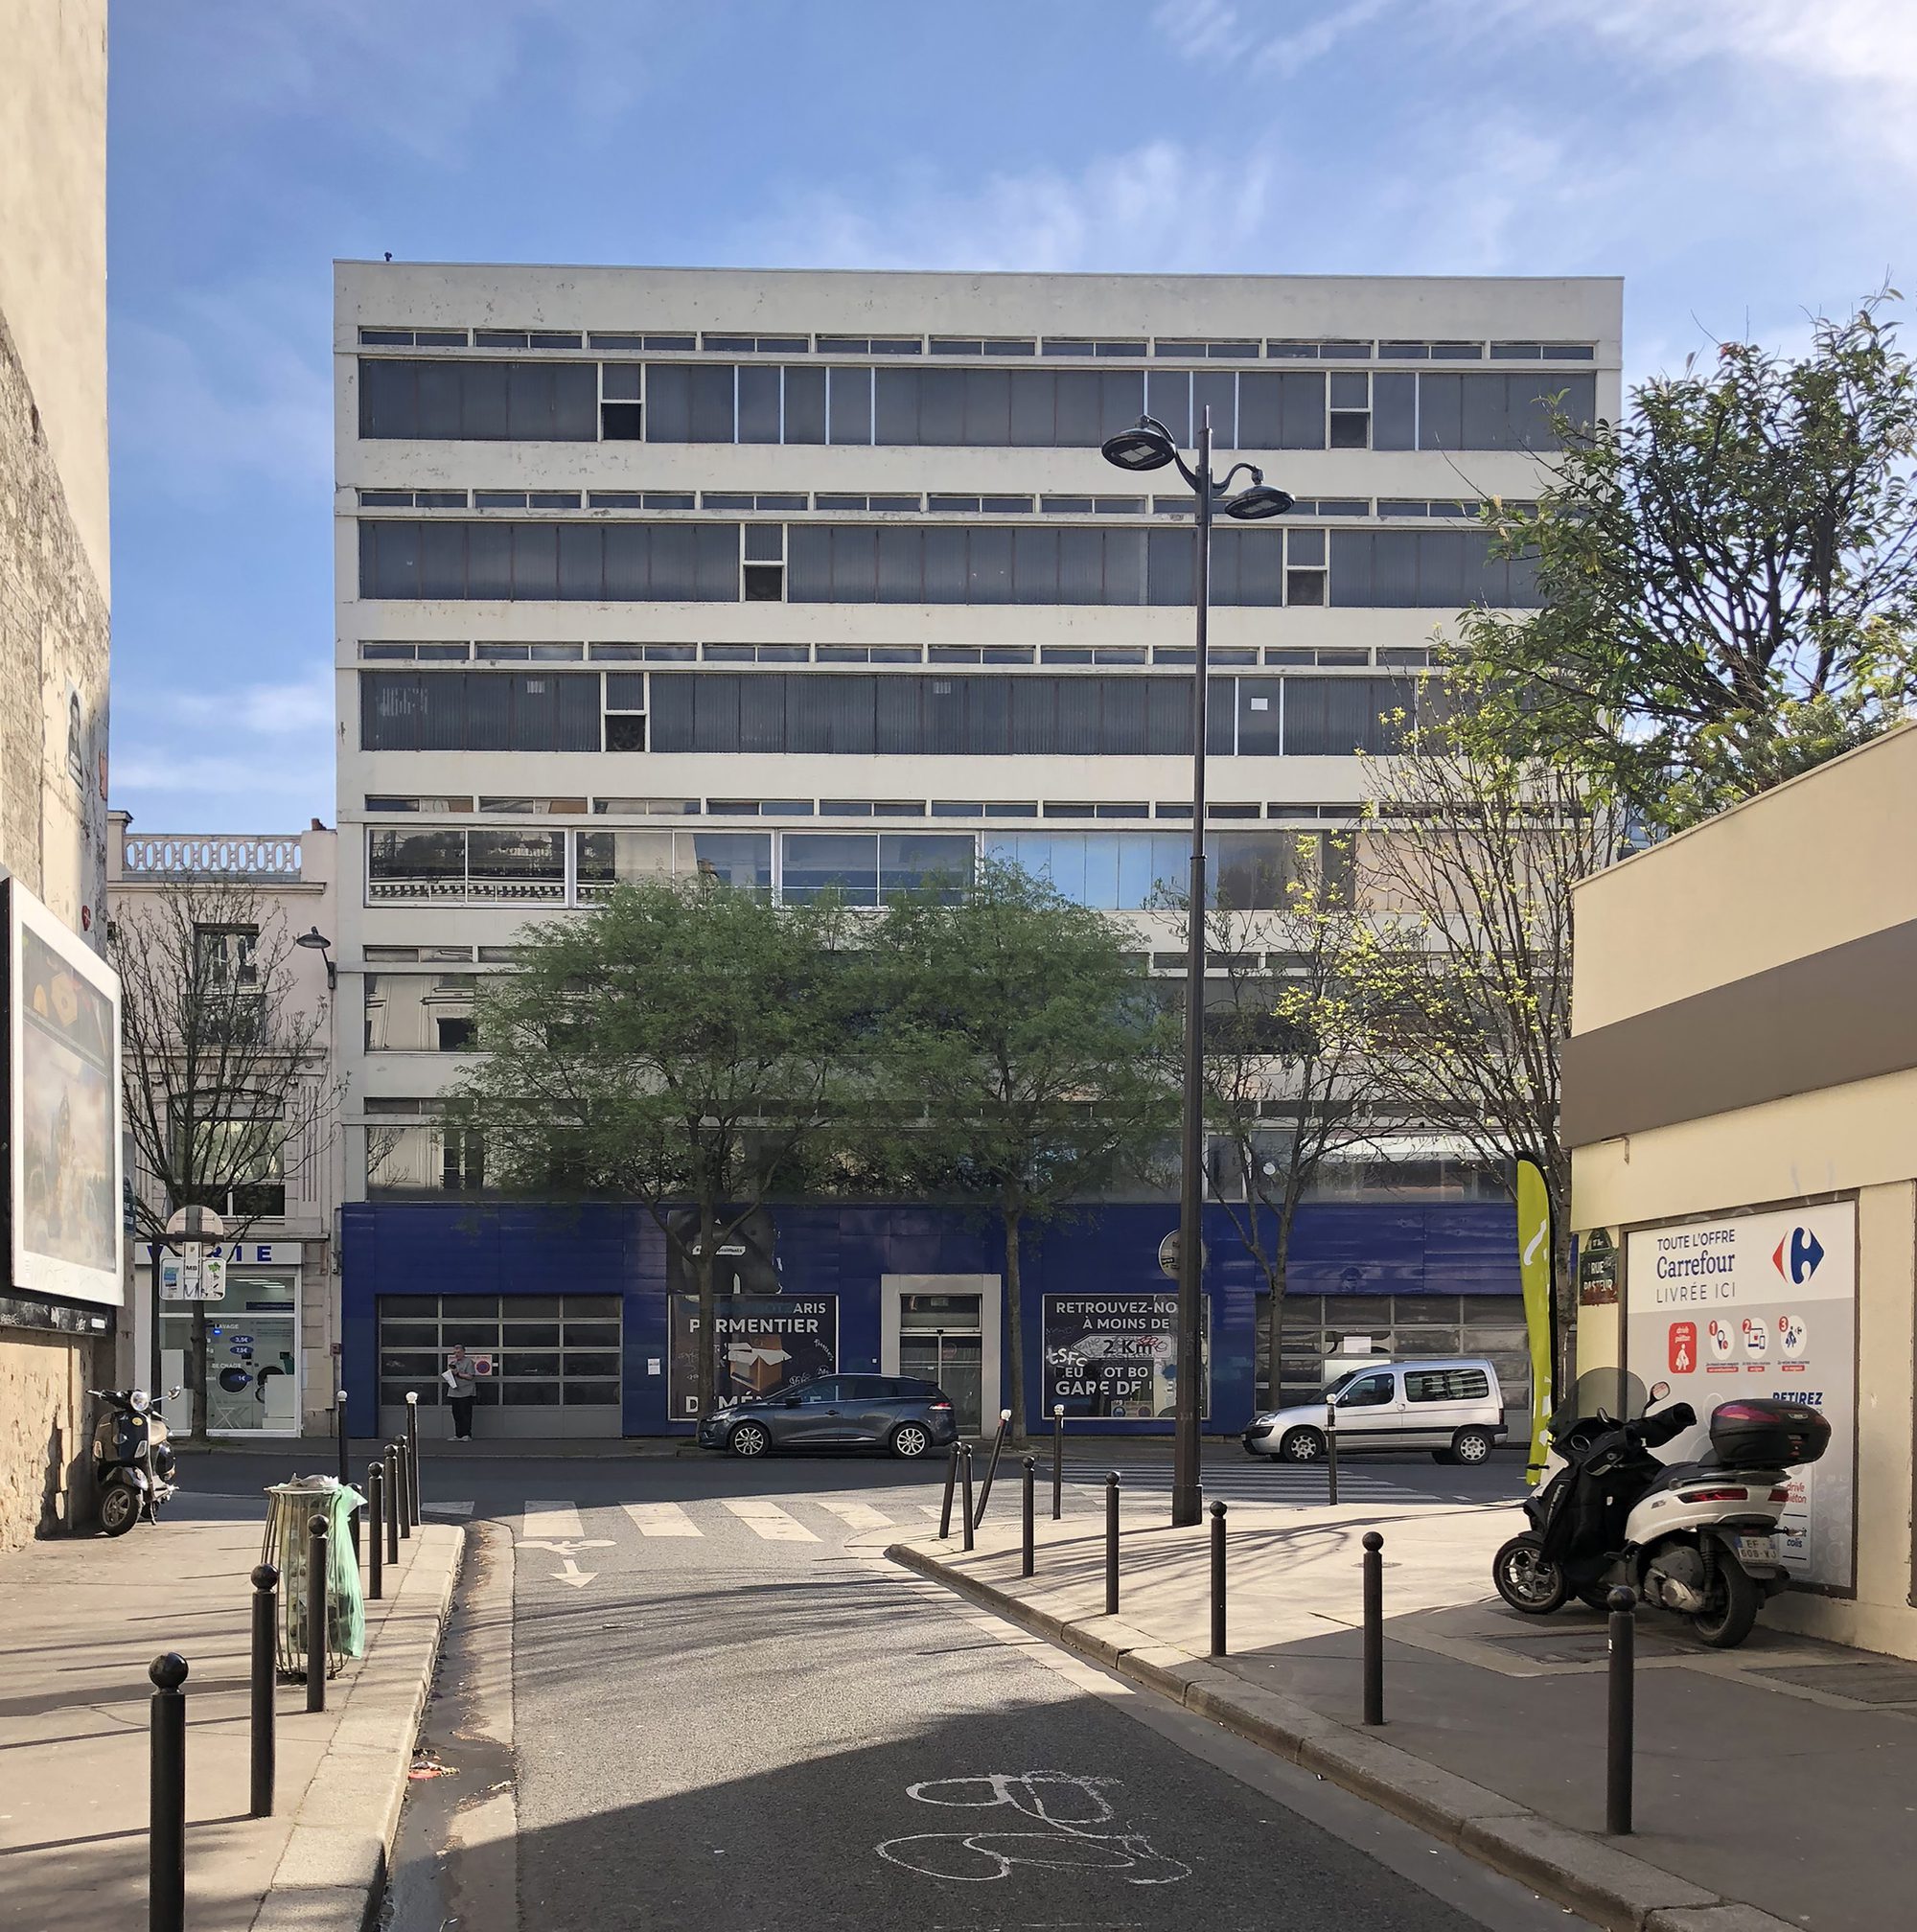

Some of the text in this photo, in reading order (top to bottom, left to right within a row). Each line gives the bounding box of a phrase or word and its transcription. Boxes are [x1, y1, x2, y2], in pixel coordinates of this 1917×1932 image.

[1657, 1230, 1736, 1252] TOUTE L'OFFRE
[1590, 1260, 1605, 1275] RUE
[1657, 1250, 1736, 1279] Carrefour
[1656, 1282, 1736, 1303] LIVRÉE ICI
[689, 1318, 819, 1334] PRMENTIER
[1082, 1316, 1169, 1329] À MOINS DE
[1103, 1339, 1116, 1354] 2
[1787, 1537, 1803, 1548] colis
